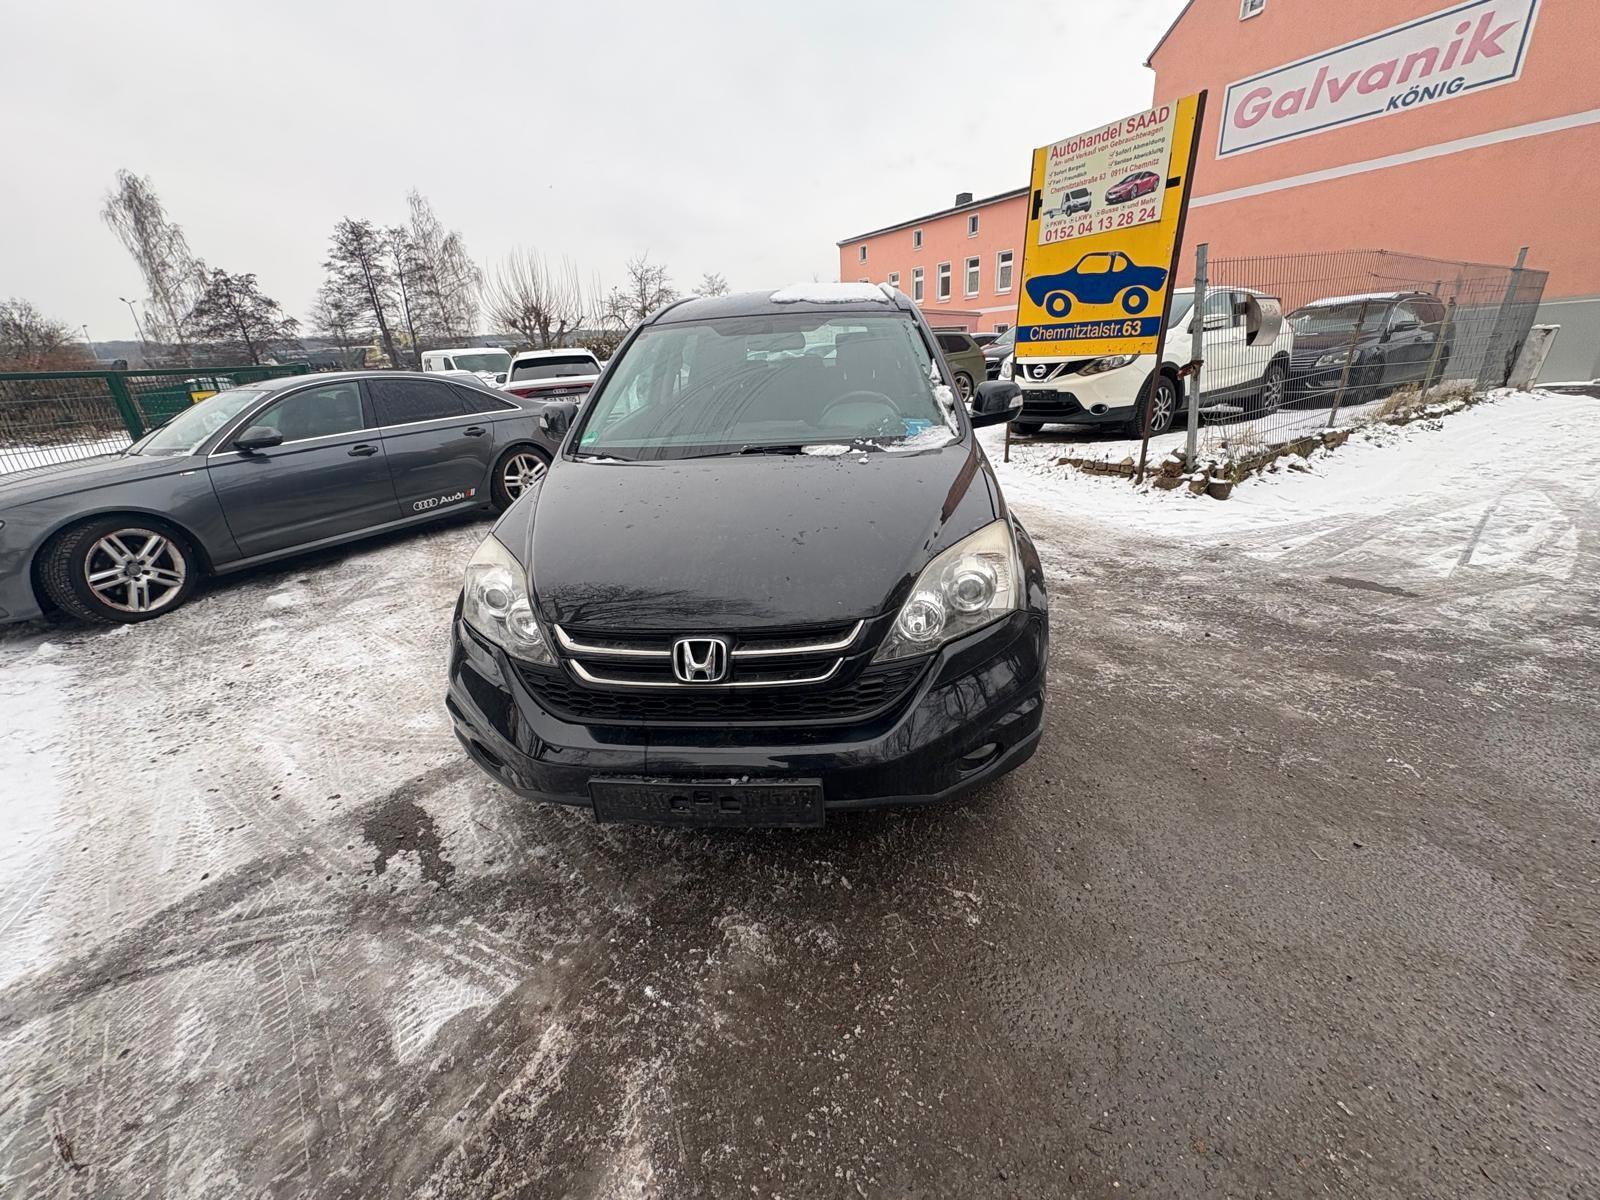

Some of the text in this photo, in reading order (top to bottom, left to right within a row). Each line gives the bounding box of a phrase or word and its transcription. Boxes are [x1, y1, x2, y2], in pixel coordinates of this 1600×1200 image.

[1233, 10, 1520, 129] Galvanik
[1385, 76, 1465, 112] KÖNIG
[1050, 106, 1170, 160] Autohandel SAAD
[1075, 146, 1097, 160] Verkauf
[1097, 144, 1109, 153] von
[1109, 126, 1164, 148] Gebrauchtwagen
[1114, 136, 1166, 157] Sofort Abmeldung
[1110, 158, 1160, 177] 09114 Chemnitz
[1045, 206, 1156, 242] 0152 04 13 28 24
[439, 491, 465, 504] Audi
